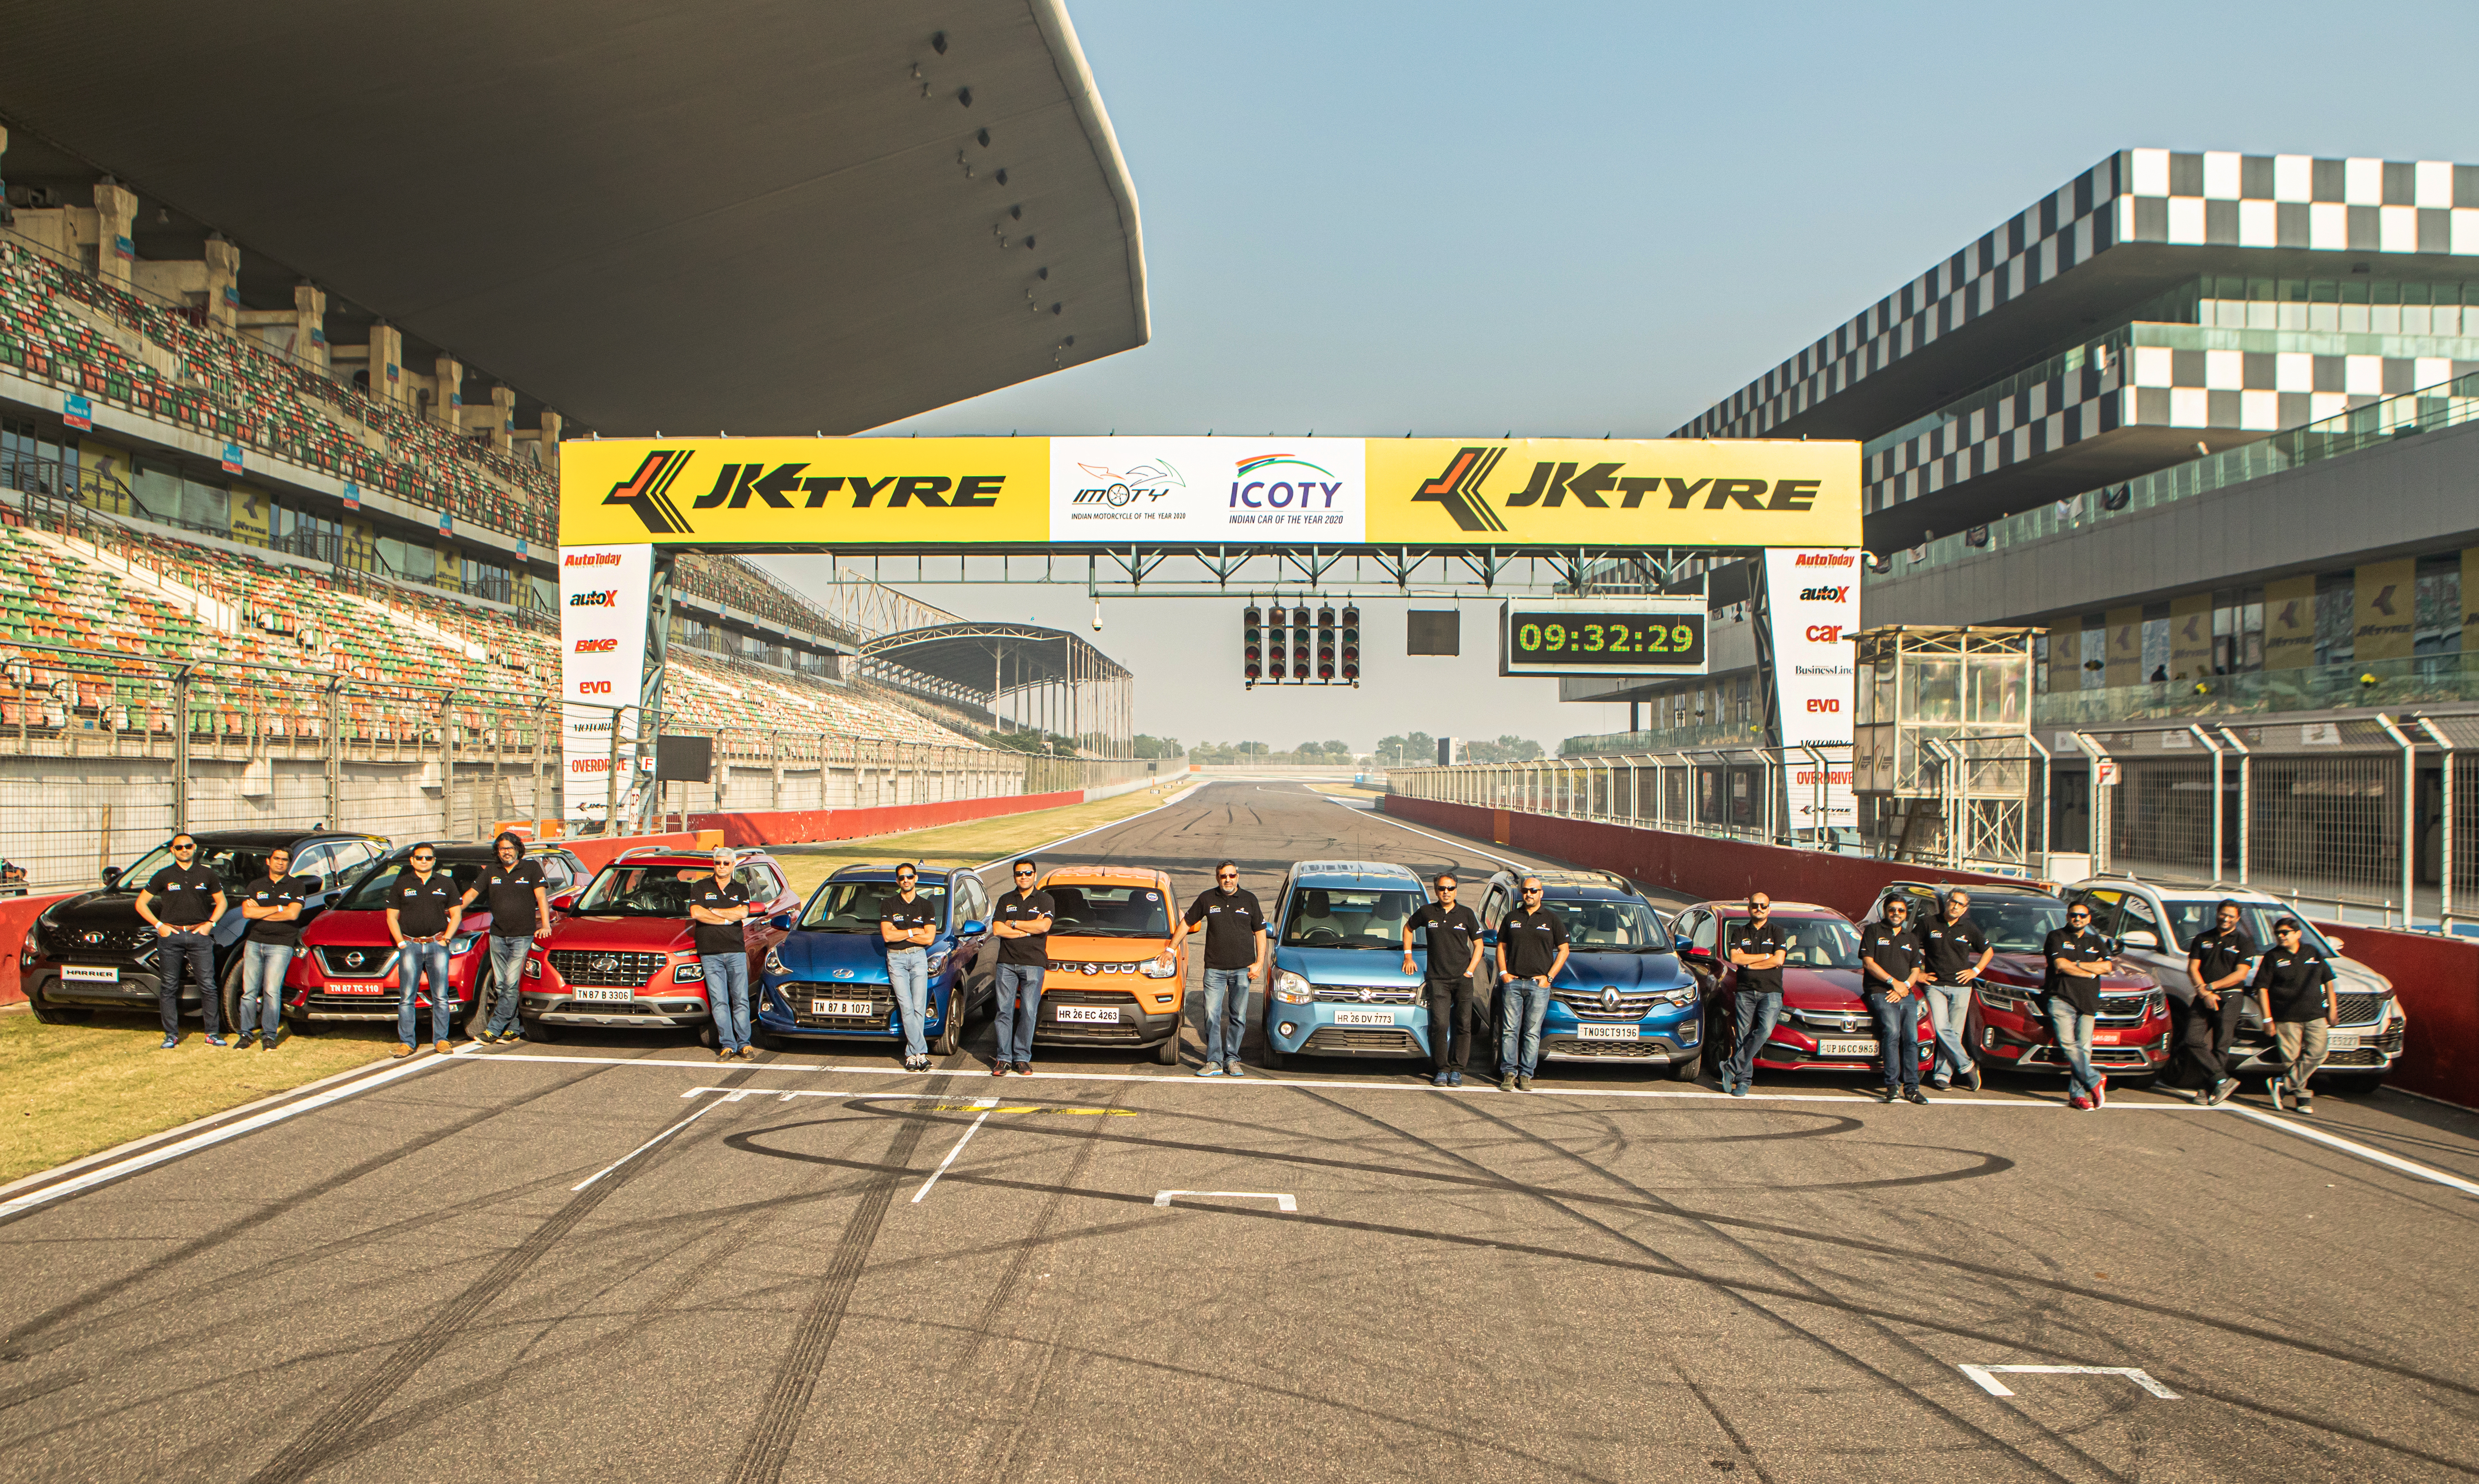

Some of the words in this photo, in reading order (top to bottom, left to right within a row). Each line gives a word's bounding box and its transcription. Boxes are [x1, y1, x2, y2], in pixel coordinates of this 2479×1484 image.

[1072, 483, 1169, 506] IMOTY
[1230, 482, 1342, 508] ICOTY
[1229, 515, 1255, 523] INDIAN
[1258, 515, 1272, 523] CAR
[1325, 516, 1343, 524] 2020
[1520, 623, 1693, 652] 09:32:29
[1806, 625, 1842, 642] car
[1796, 666, 1853, 674] BusinessLine
[580, 681, 611, 693] evo
[1807, 699, 1839, 712] evo
[645, 758, 653, 770] F
[2100, 765, 2112, 783] F
[815, 1003, 824, 1012] TN
[829, 1003, 837, 1012] 87
[842, 1003, 846, 1012] B
[852, 1004, 869, 1013] 1073
[1584, 1028, 1636, 1037] TN09CT9196
